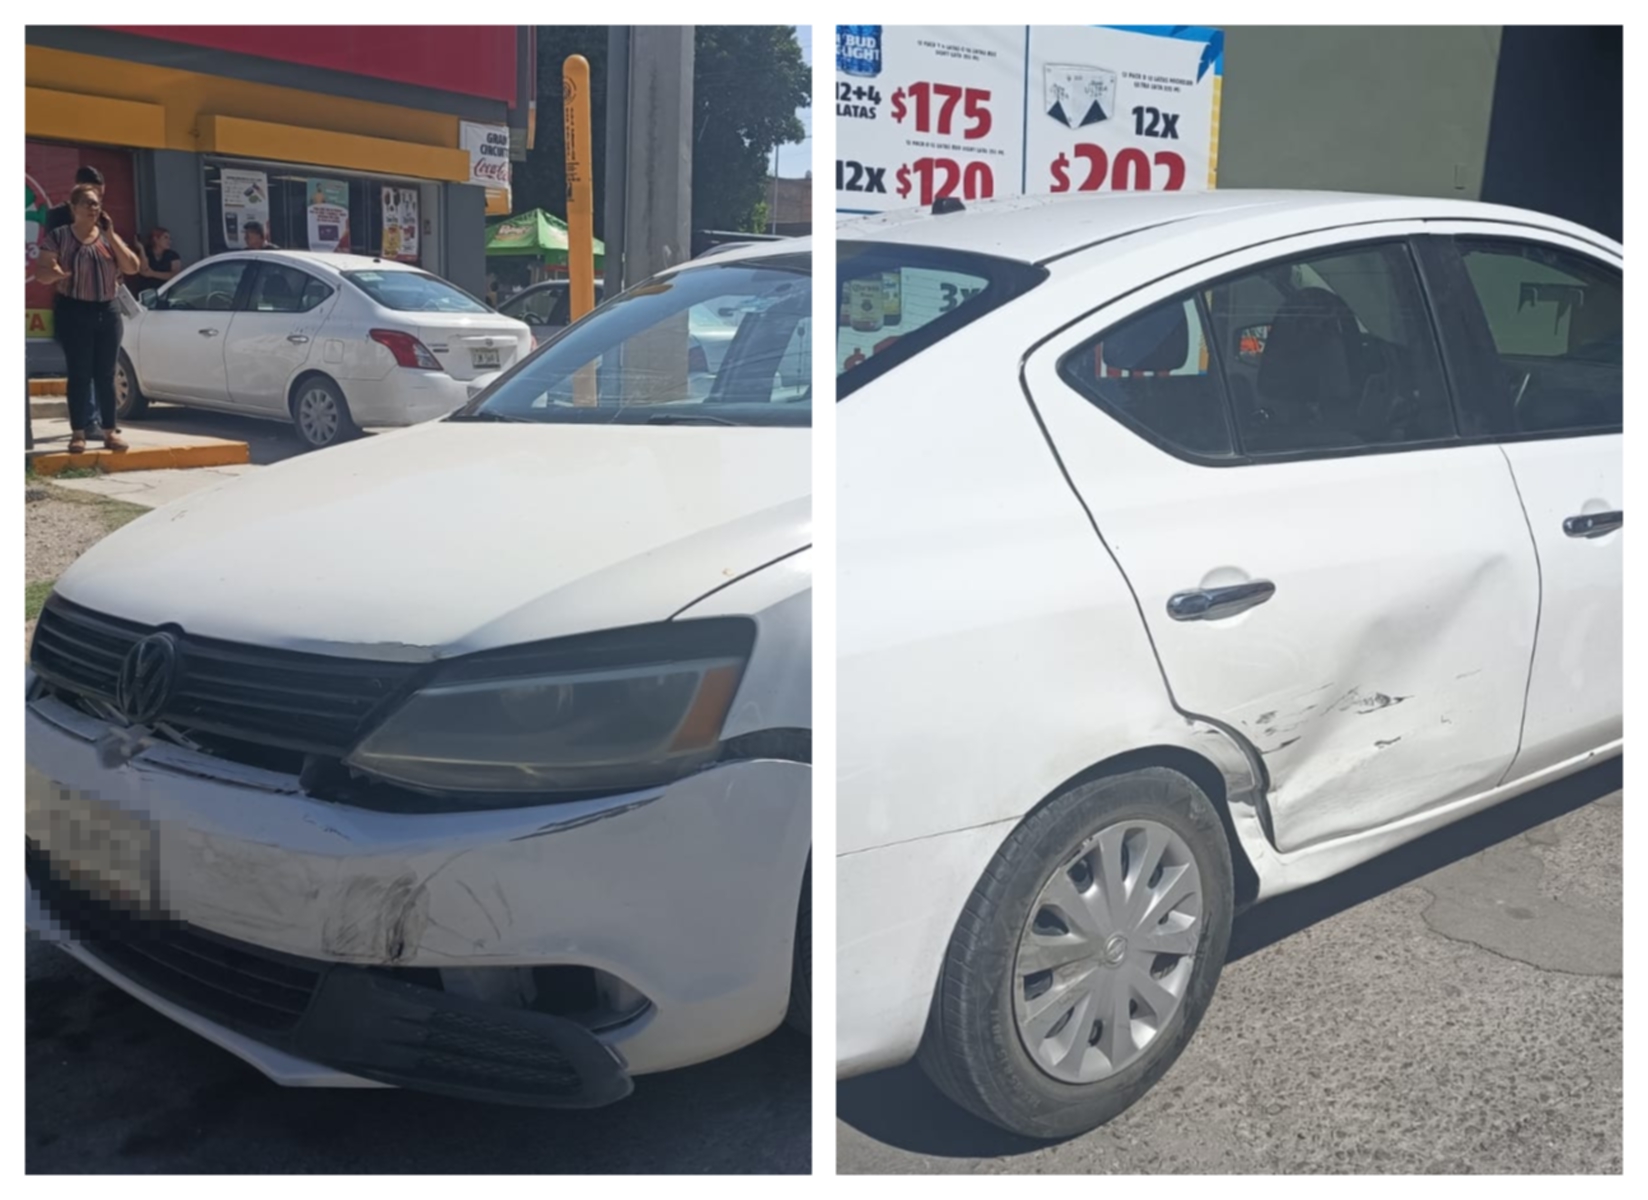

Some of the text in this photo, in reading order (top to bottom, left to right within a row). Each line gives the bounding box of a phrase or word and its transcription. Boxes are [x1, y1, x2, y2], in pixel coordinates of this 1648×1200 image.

[842, 46, 880, 61] LIGHT
[845, 34, 876, 49] BUD
[836, 103, 876, 119] LATAS
[891, 81, 992, 140] $175
[895, 157, 993, 206] $120
[1050, 143, 1186, 193] $202
